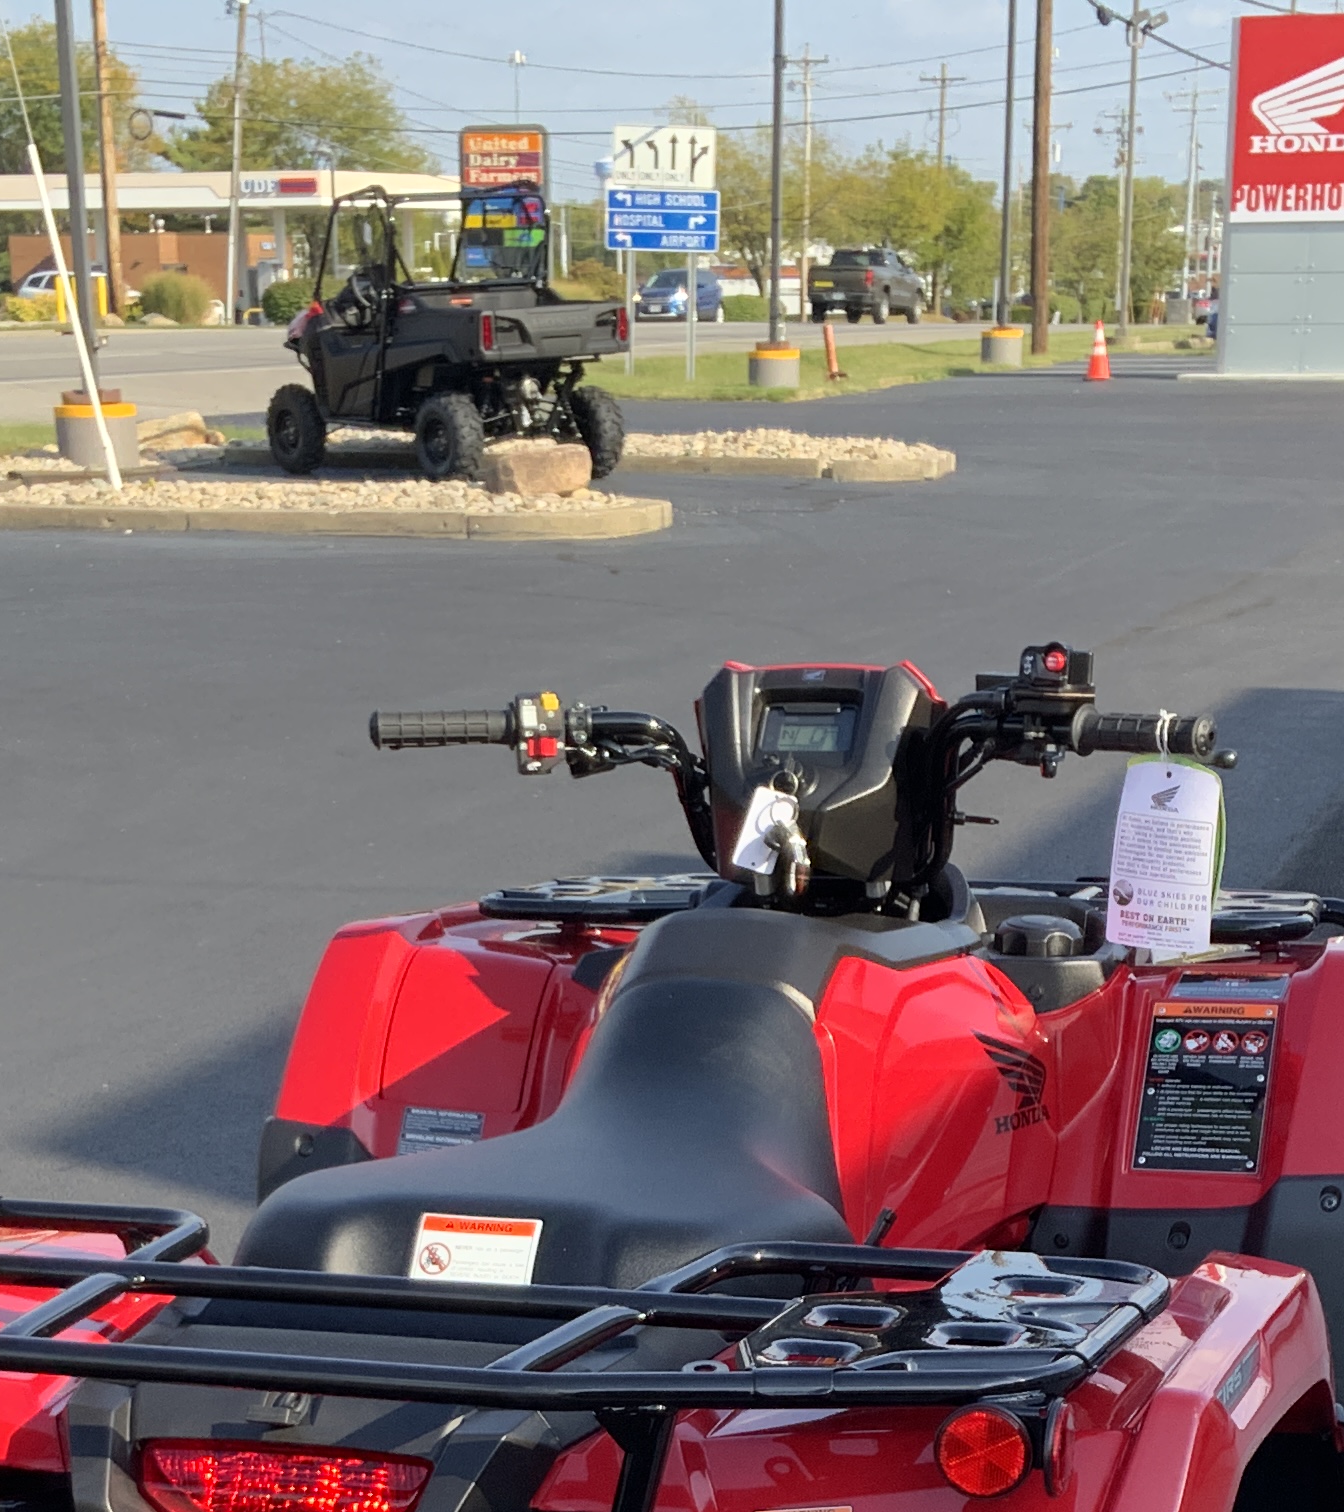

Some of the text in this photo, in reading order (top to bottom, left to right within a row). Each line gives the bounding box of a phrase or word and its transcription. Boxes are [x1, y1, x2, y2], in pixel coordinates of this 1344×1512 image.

[469, 137, 530, 151] United
[469, 153, 518, 168] Dairy
[634, 193, 707, 207] HIGH SCHOOL
[660, 235, 707, 248] AIRPORT
[1137, 887, 1208, 902] BLUE SKIES FOR
[1137, 897, 1207, 912] OUR CHILDREN
[1120, 909, 1141, 920] BEST
[1143, 913, 1155, 922] ON
[1121, 920, 1163, 932] PERFORMANCE
[1192, 1006, 1245, 1015] WARNING
[994, 1104, 1051, 1135] HONDA
[459, 1221, 513, 1233] WARNING
